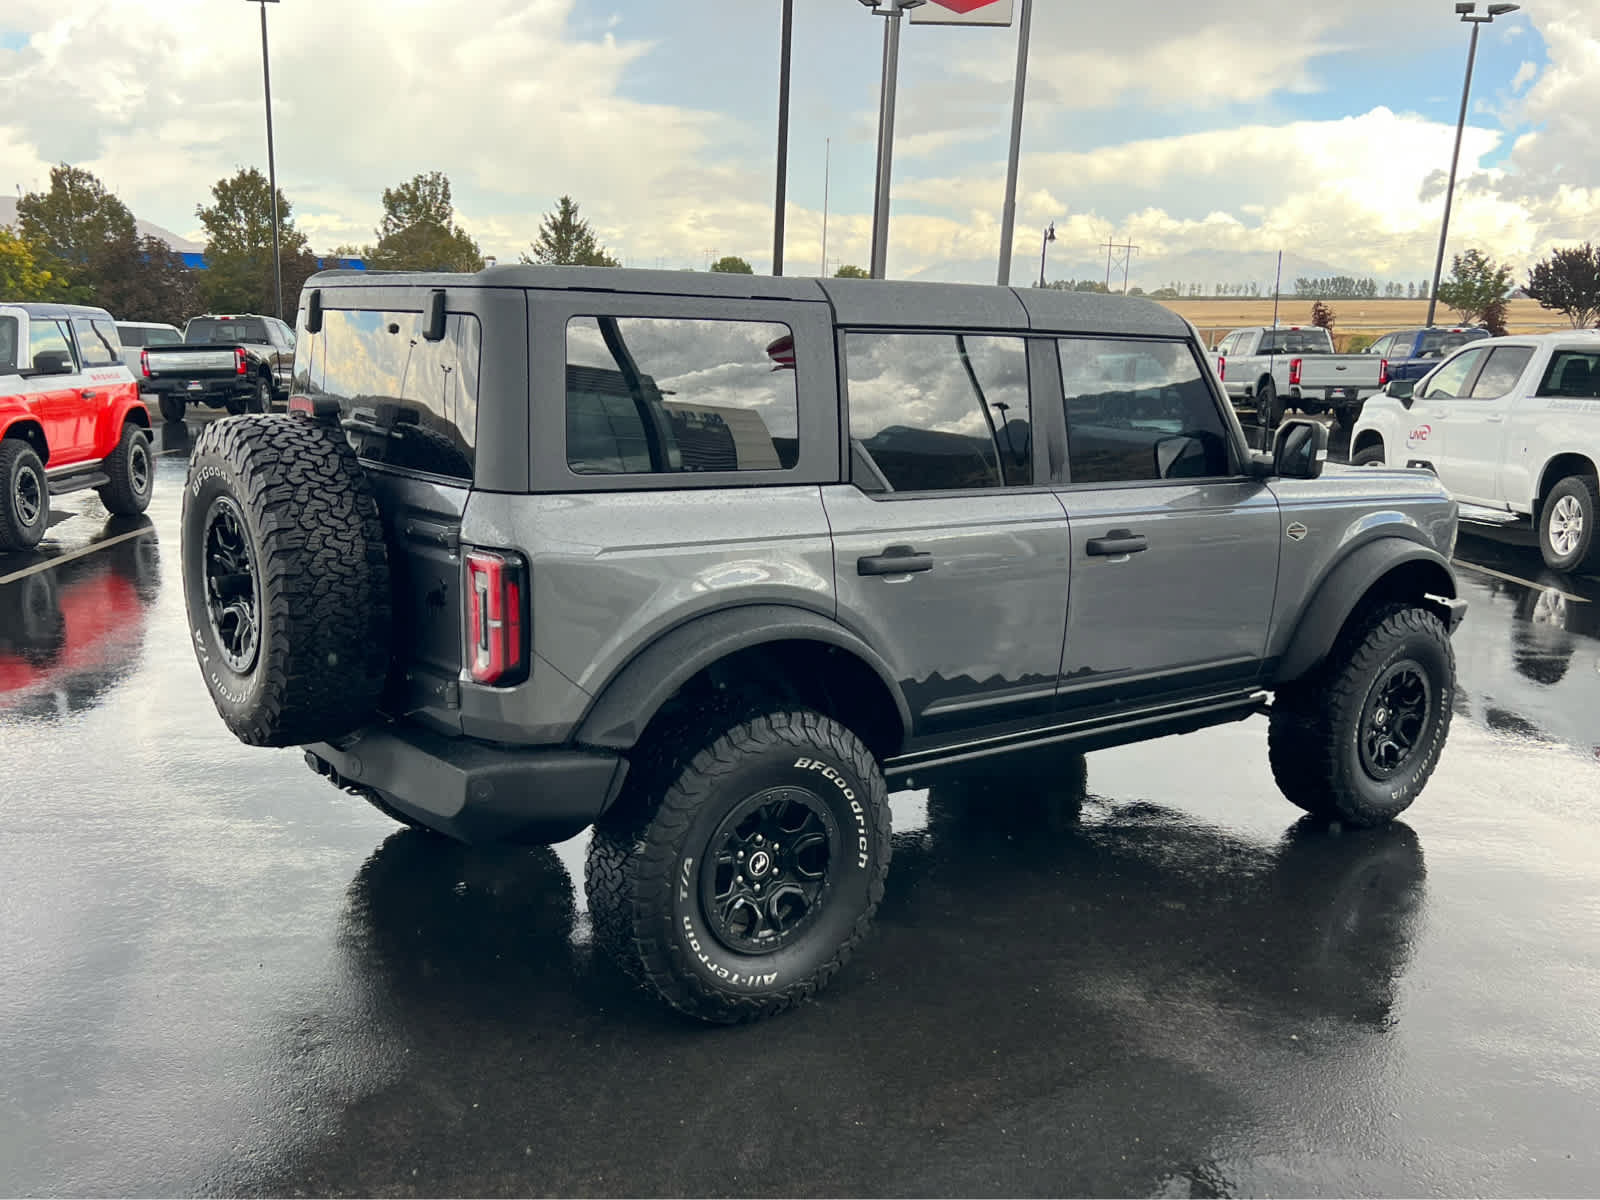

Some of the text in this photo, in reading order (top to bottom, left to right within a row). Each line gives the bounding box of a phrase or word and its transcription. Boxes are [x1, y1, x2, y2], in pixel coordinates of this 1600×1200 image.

[793, 757, 868, 869] BFGoodrich
[680, 858, 778, 987] All-Terrain T/A
